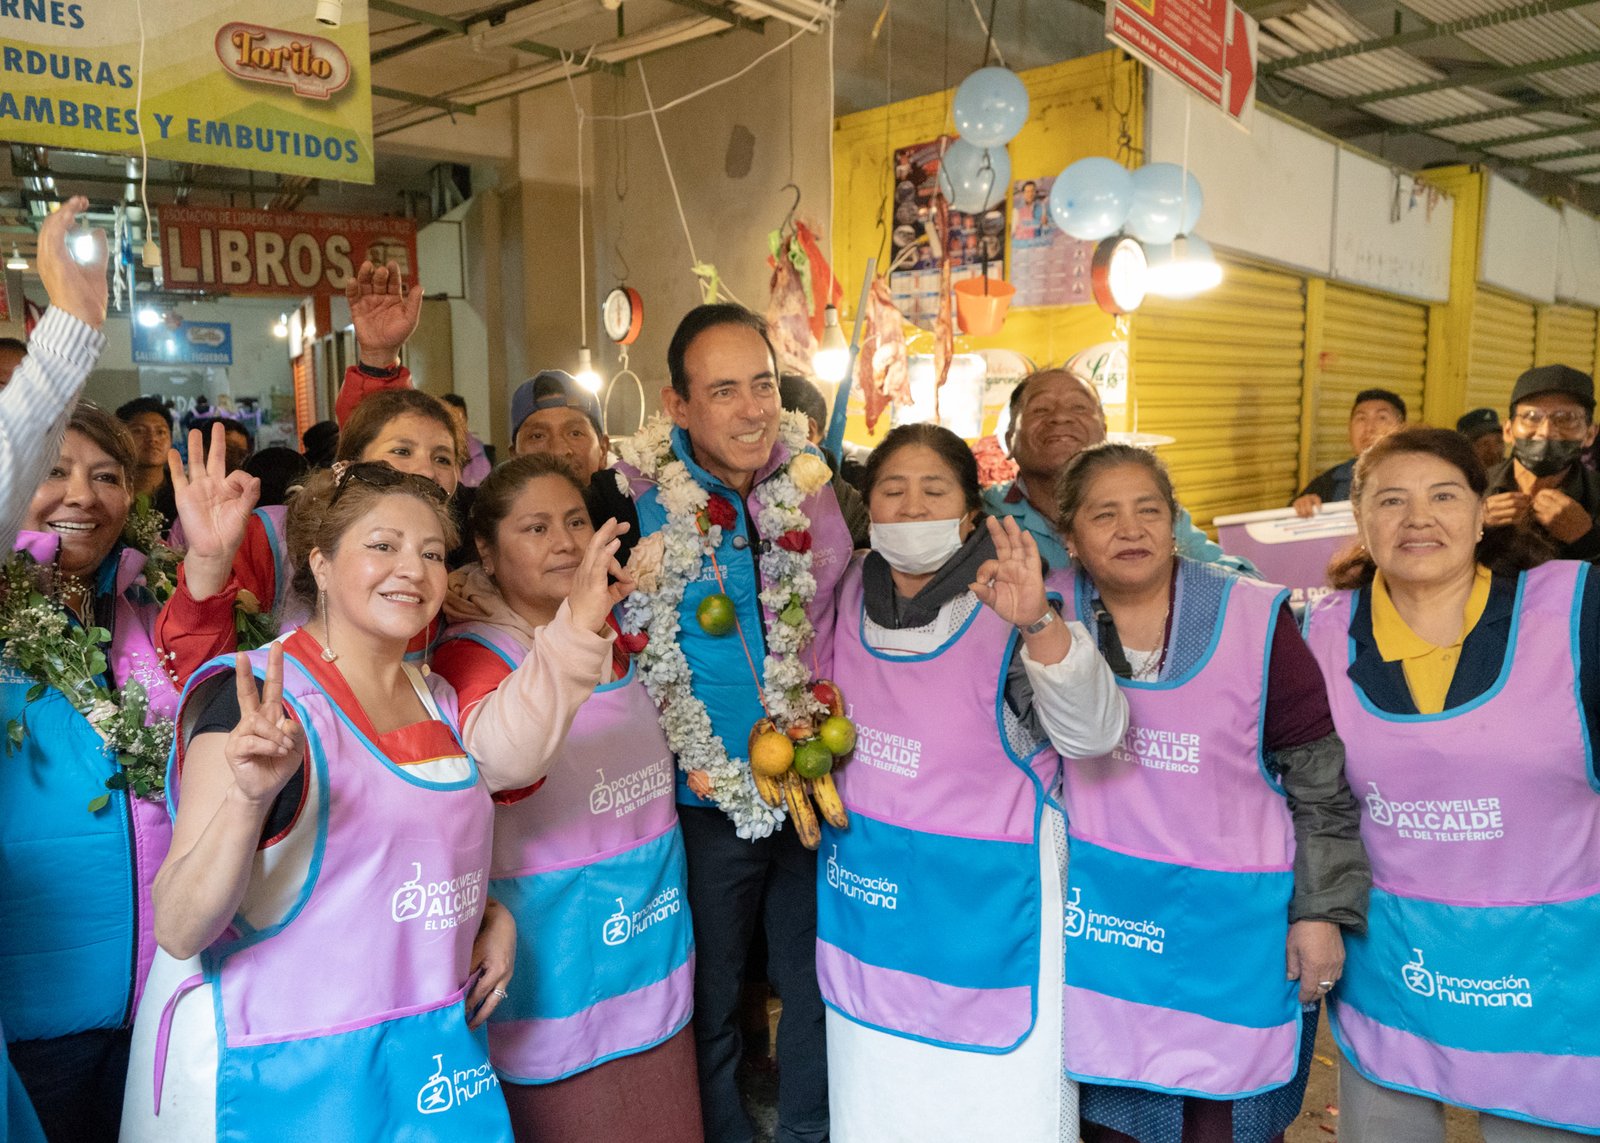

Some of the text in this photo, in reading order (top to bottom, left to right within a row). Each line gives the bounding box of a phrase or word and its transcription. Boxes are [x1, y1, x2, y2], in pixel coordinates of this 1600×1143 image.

[1, 0, 84, 29] RNES
[4, 47, 133, 88] RDURAS
[232, 29, 332, 80] Torito
[0, 92, 358, 163] AMBRES Y EMBUTIDOS
[167, 227, 354, 290] LIBROS
[855, 723, 922, 753] DOCKWEILER
[1117, 736, 1200, 764] ALCALDE
[1129, 726, 1200, 746] CKWEILER
[855, 735, 921, 769] ALCALDE
[860, 754, 873, 766] DEL
[1112, 750, 1123, 761] EL
[1124, 753, 1139, 764] DEL
[611, 757, 670, 792] DOCKWEILE
[615, 773, 671, 808] ALCALDE
[1390, 797, 1501, 813] DOCKWEILER
[615, 808, 625, 818] EL
[624, 802, 636, 813] DEL
[1397, 811, 1503, 831] ALCALDE
[1398, 828, 1504, 842] EL DEL TELEFÉRICO
[427, 868, 484, 897] DOCKWEILE
[840, 865, 899, 894] innovación
[840, 878, 897, 910] humana
[426, 884, 480, 918] ALCALD
[632, 886, 679, 923] innovación
[424, 920, 438, 931] EL
[440, 916, 457, 929] DEL
[632, 899, 681, 938] humana
[1088, 909, 1166, 939] innovación
[1086, 923, 1164, 955] humana
[1435, 971, 1530, 990] innovación
[1437, 984, 1533, 1008] humana
[453, 1057, 492, 1086] innov
[455, 1072, 499, 1106] hum
